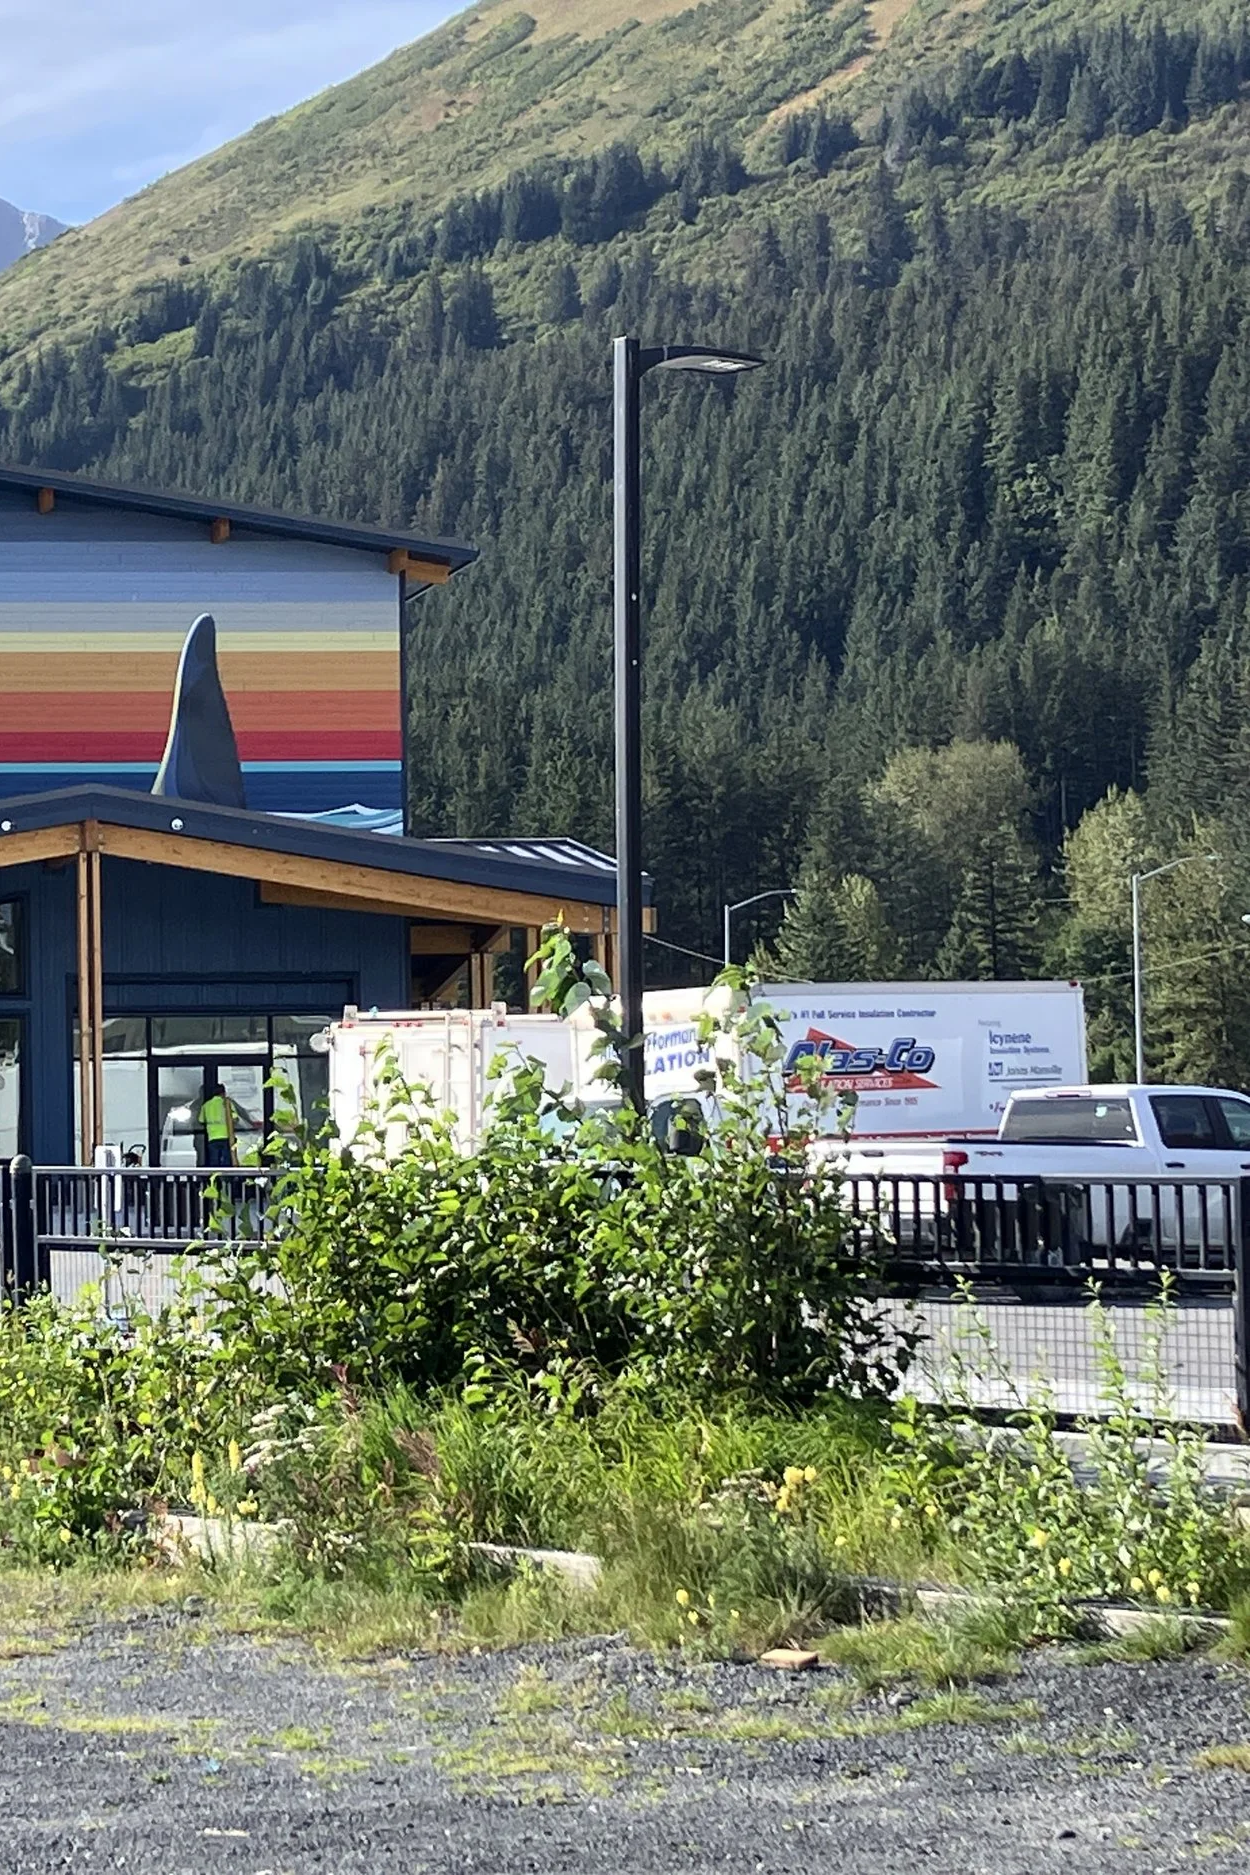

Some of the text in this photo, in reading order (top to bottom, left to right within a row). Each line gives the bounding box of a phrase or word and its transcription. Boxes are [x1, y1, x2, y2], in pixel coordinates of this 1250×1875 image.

[812, 1010, 825, 1019] Full
[828, 1010, 856, 1019] Service
[859, 1009, 894, 1018] Insulation
[897, 1008, 936, 1017] Contractor
